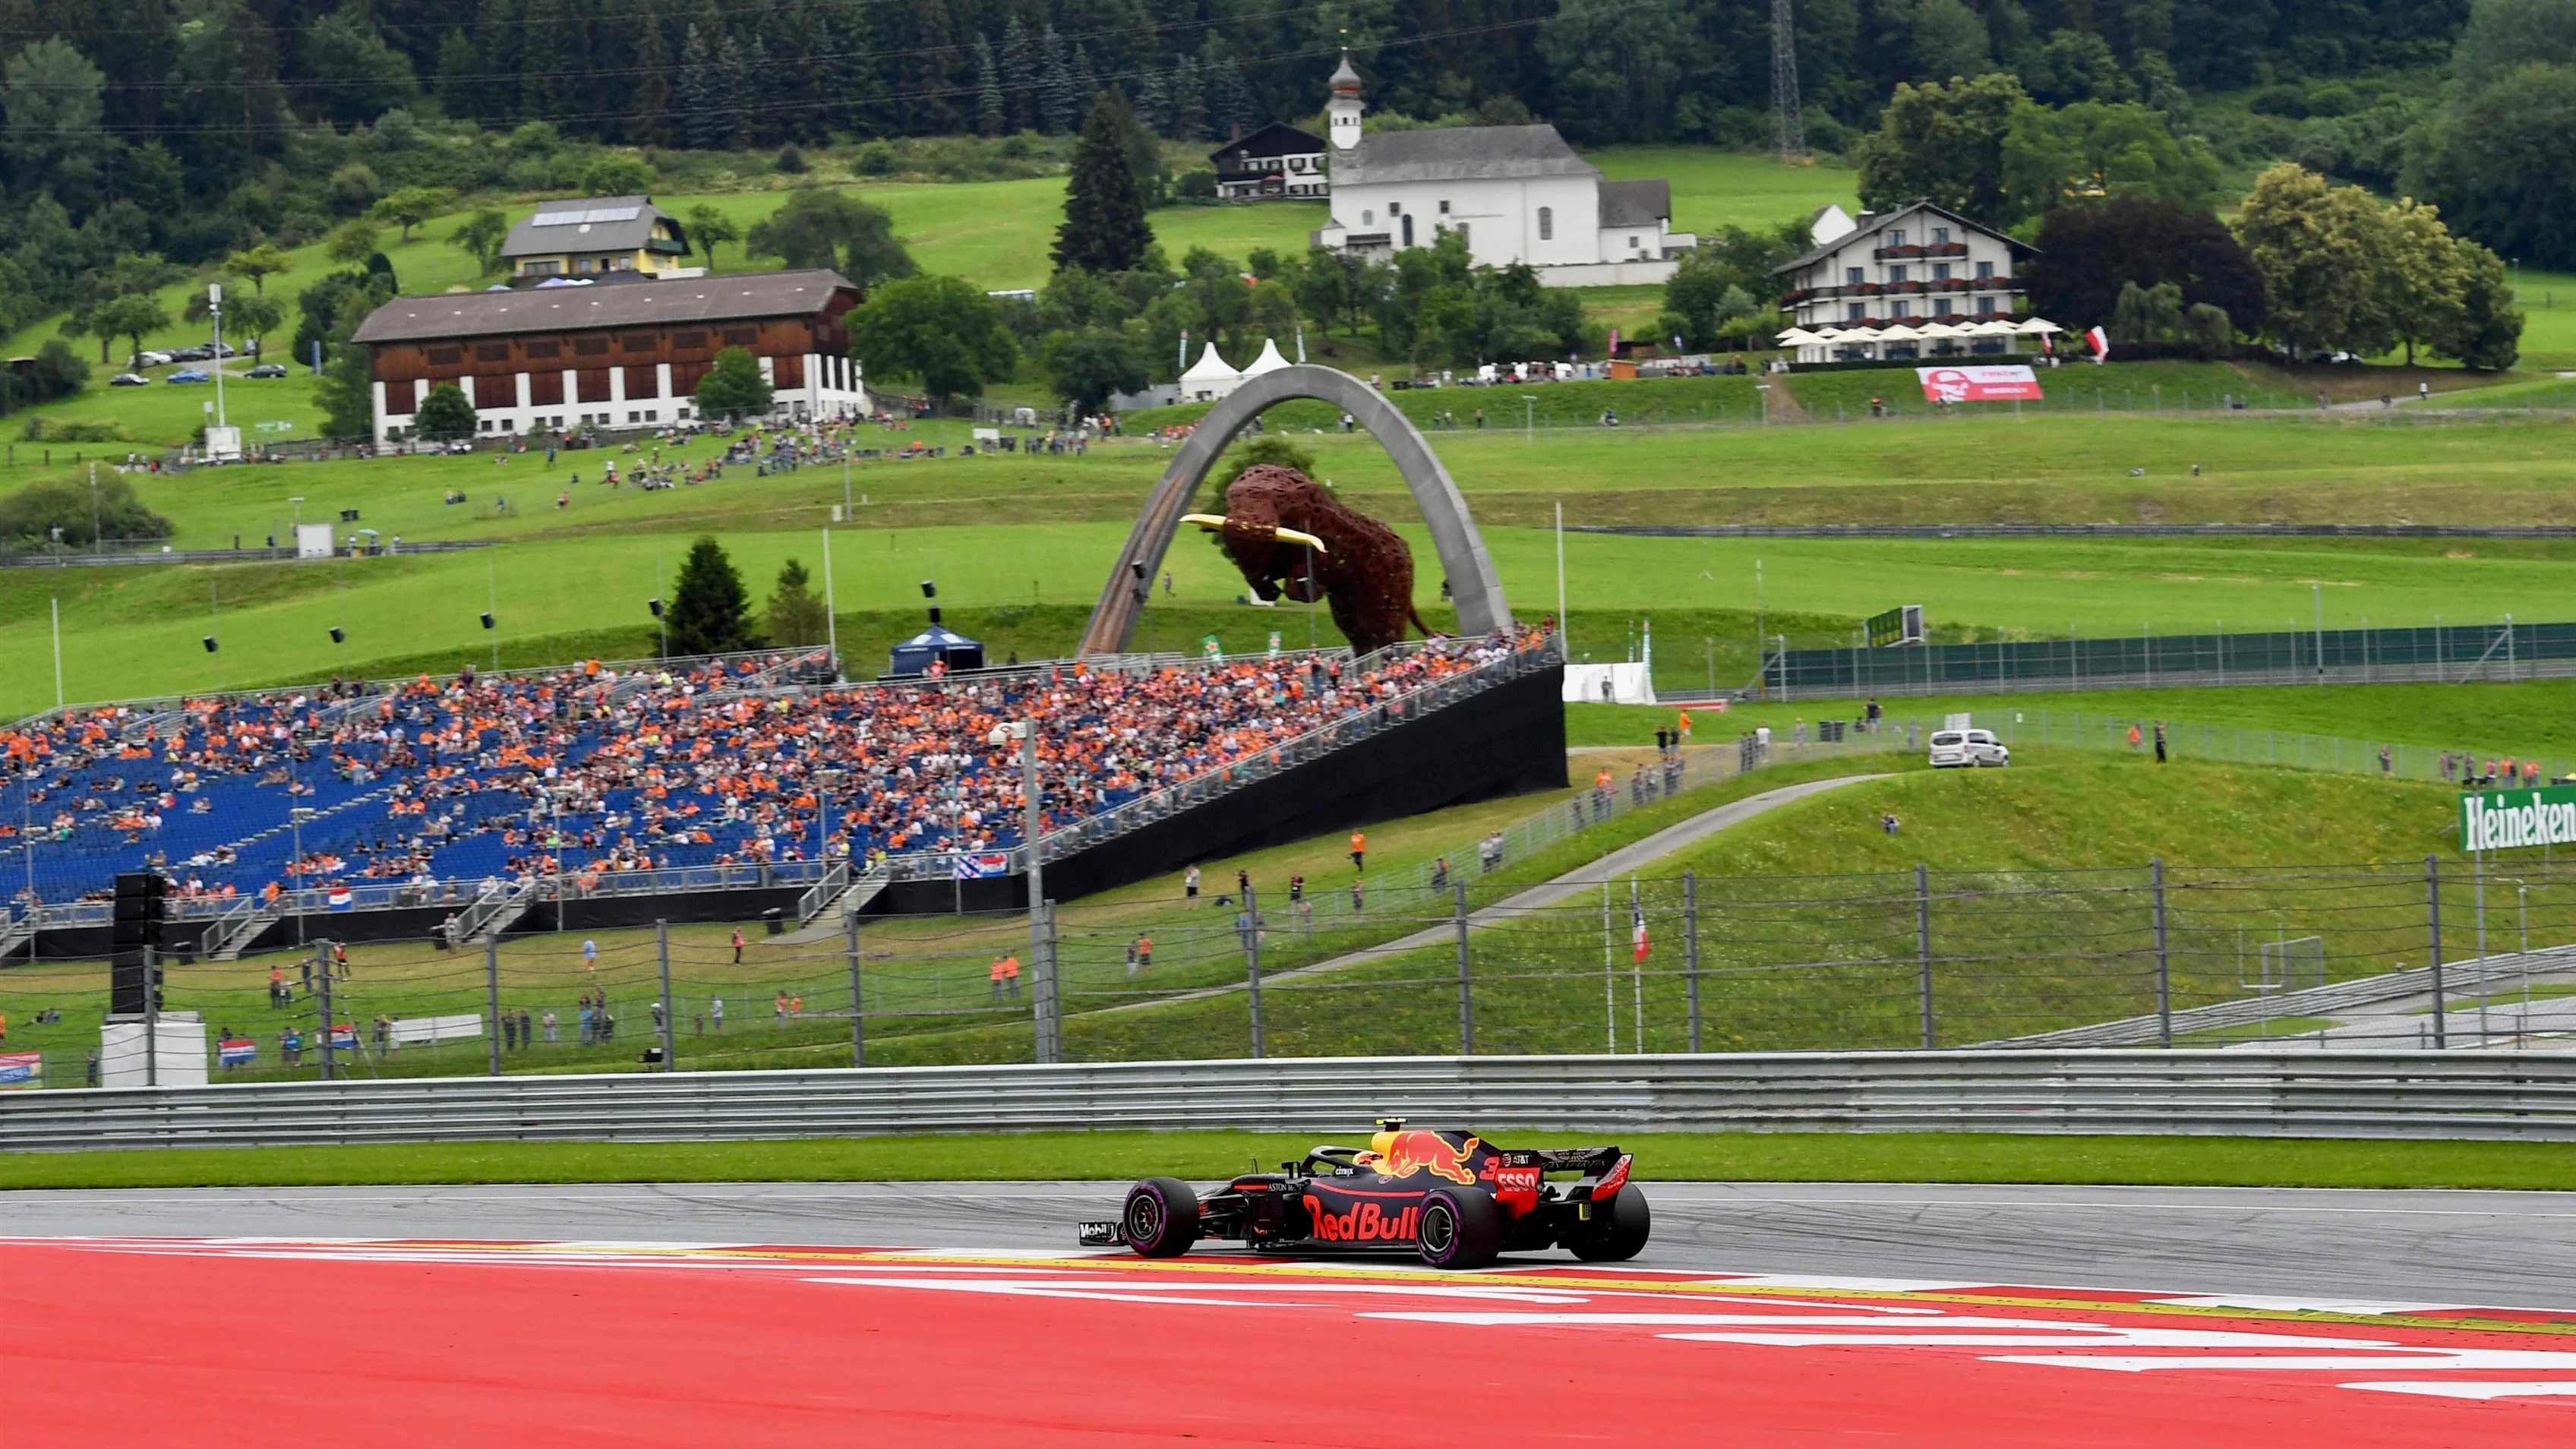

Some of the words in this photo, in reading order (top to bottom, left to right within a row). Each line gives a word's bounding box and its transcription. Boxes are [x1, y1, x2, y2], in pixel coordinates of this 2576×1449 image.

[2464, 792, 2576, 851] Heineken
[1479, 1157, 1500, 1180] 3
[1514, 1154, 1530, 1164] AT&T
[1267, 1183, 1286, 1192] ASTON
[1498, 1173, 1536, 1192] ESSO
